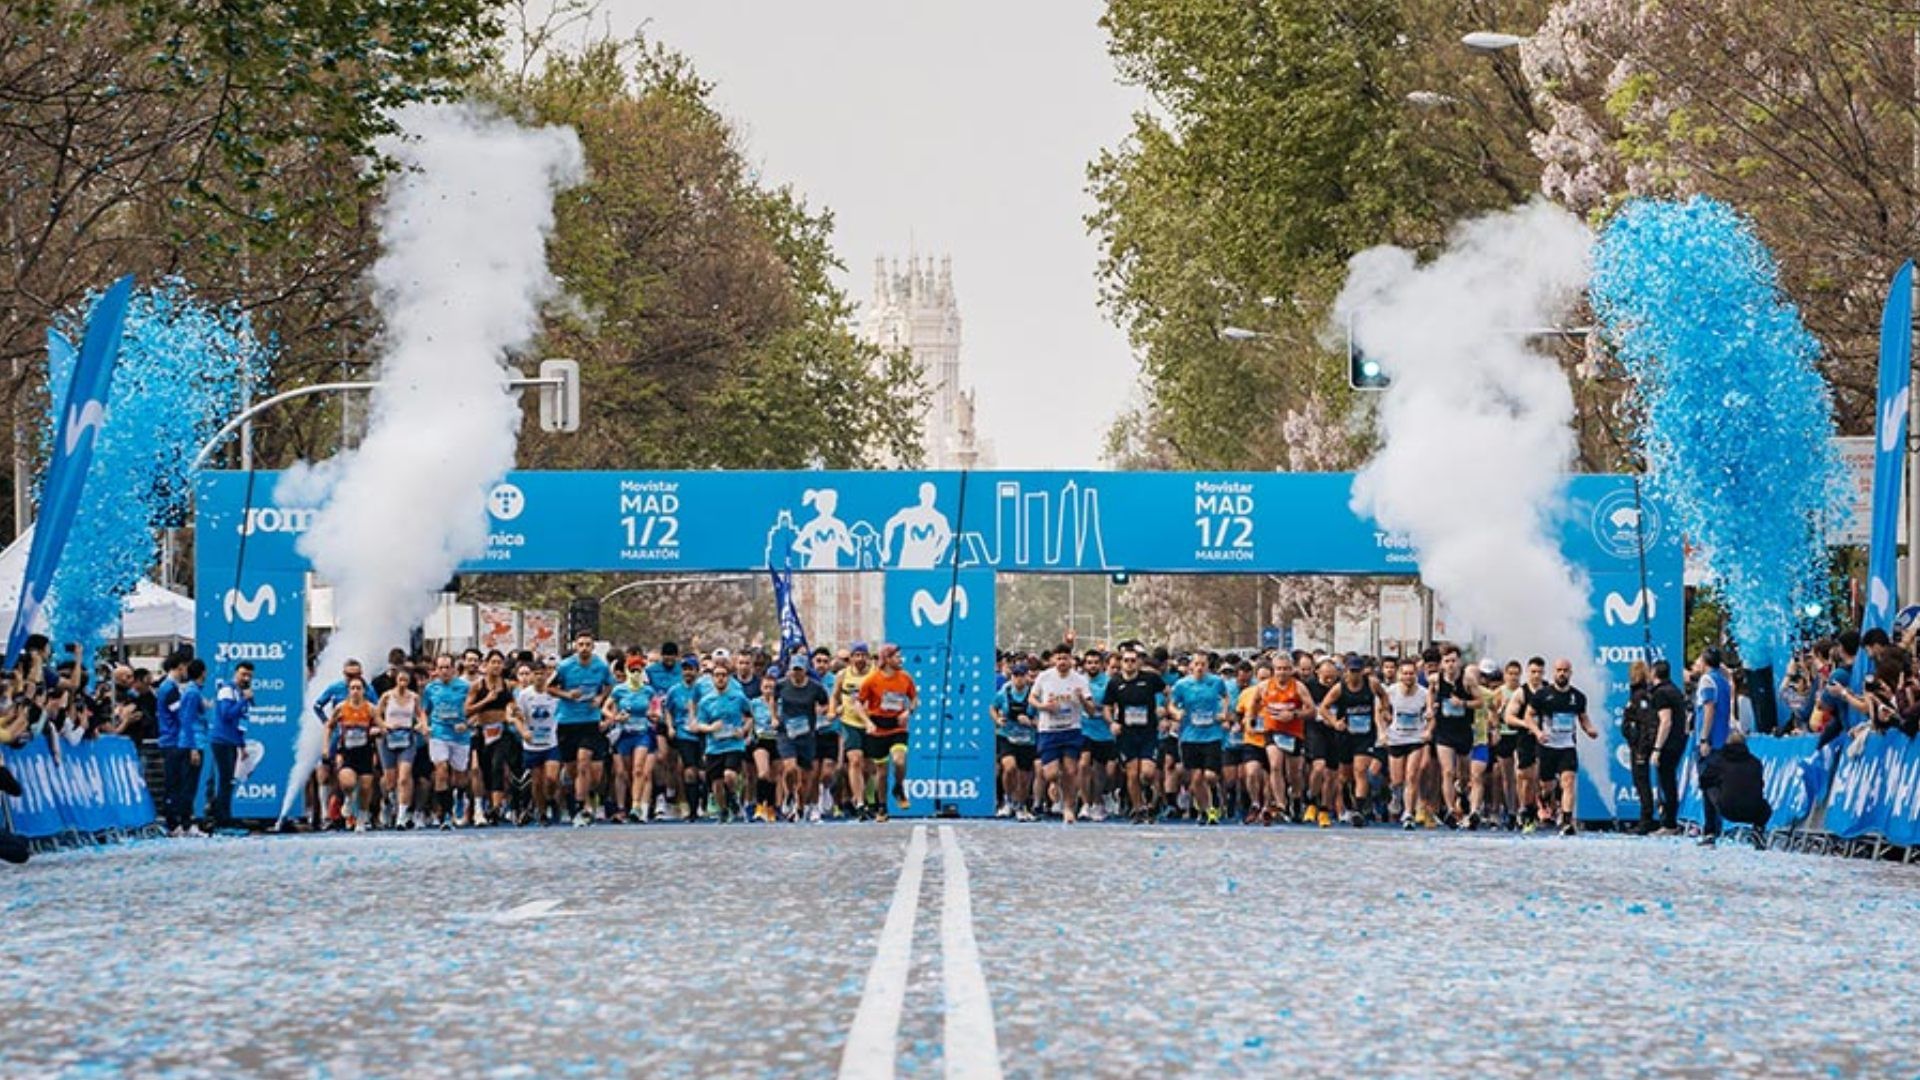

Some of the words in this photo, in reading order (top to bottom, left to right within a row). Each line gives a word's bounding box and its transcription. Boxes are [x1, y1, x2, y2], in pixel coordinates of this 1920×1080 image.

[620, 480, 679, 492] Movistar
[1195, 481, 1254, 493] Movistar
[620, 494, 679, 514] MAD
[1195, 495, 1254, 515] MAD
[236, 507, 318, 536] Jom
[620, 516, 679, 547] 1/2
[1195, 517, 1254, 547] 1/2
[214, 642, 286, 662] Joma
[235, 784, 277, 798] ADM
